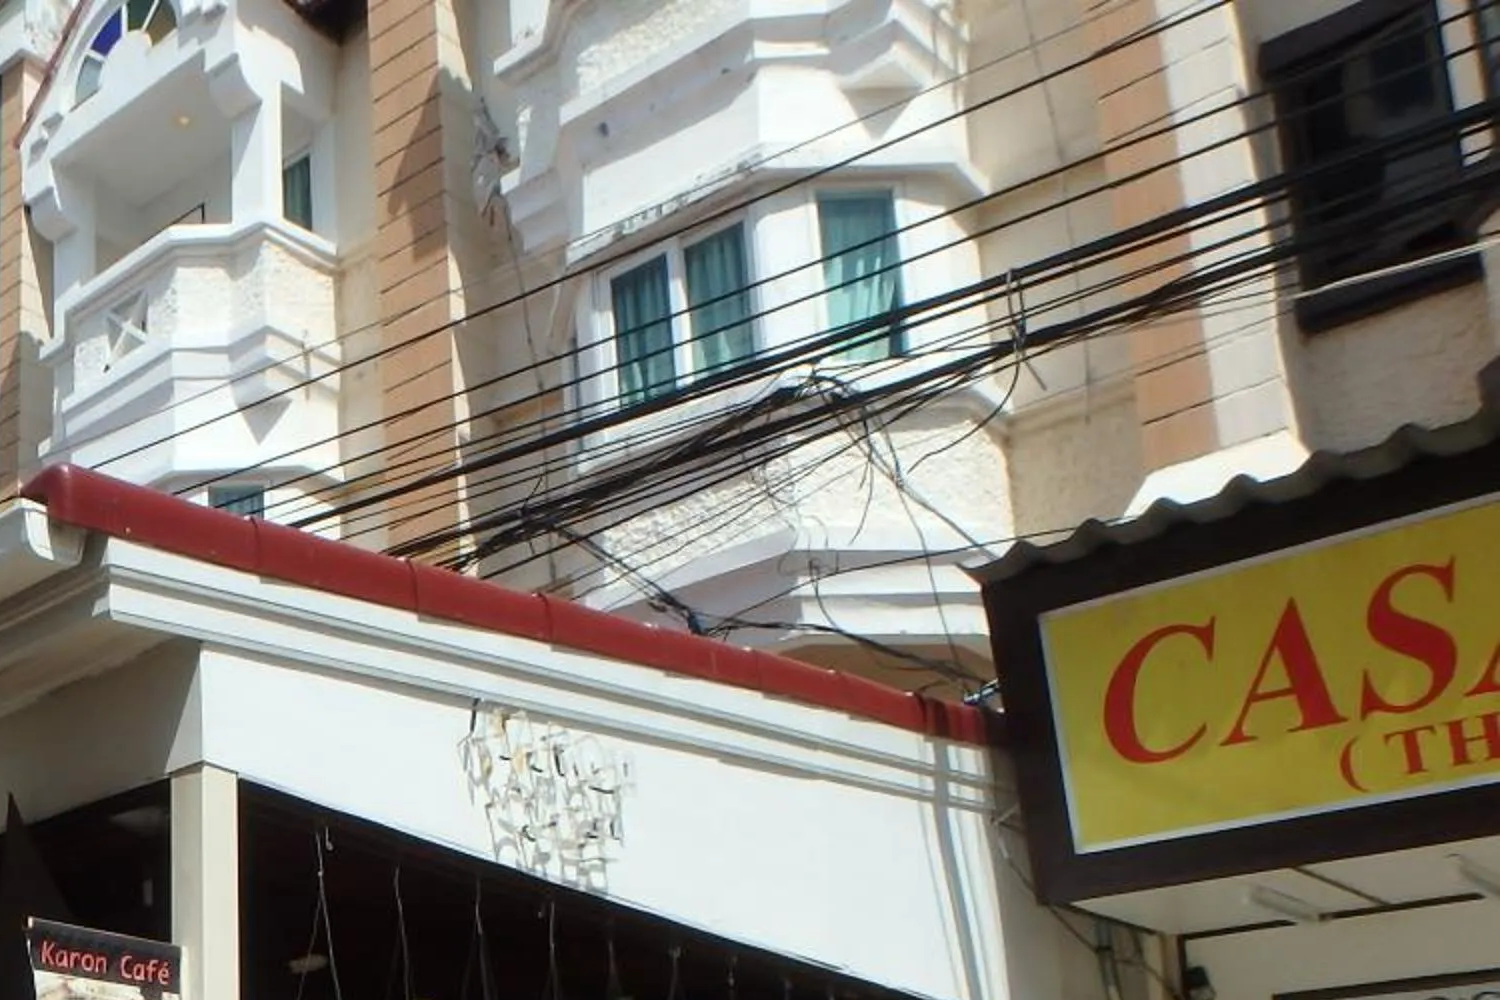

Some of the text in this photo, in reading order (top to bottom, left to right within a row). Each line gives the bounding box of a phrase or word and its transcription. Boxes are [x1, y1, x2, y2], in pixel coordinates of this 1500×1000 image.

[1103, 555, 1500, 764] CAS
[41, 940, 171, 985] Karon Café
